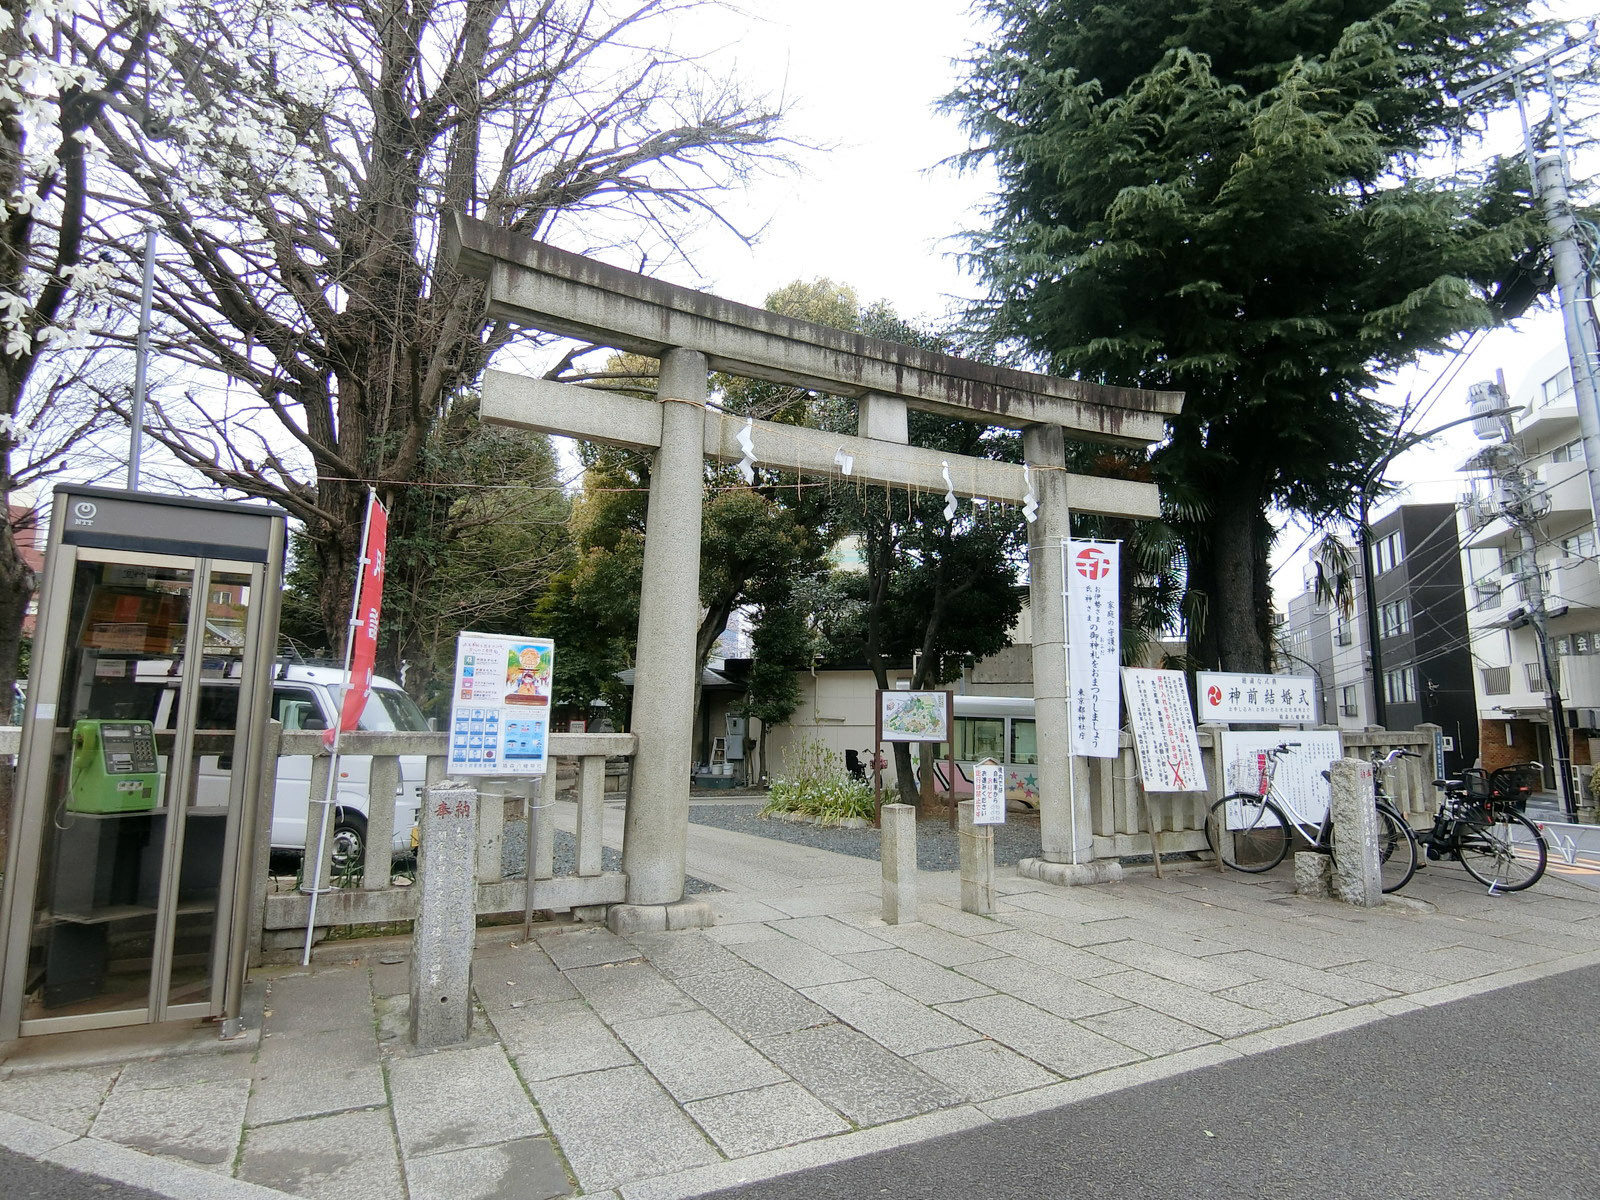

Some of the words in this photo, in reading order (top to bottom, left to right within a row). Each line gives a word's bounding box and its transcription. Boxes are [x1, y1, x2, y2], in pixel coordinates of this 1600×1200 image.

[1085, 585, 1093, 622] 氏神さま
[1093, 586, 1102, 624] お伊勢さま
[1106, 600, 1116, 655] 家庭の守護神
[1088, 624, 1100, 748] の御神札をおまつりしましょう
[1228, 687, 1310, 707] 神前結婚式
[1077, 688, 1086, 740] 東京都神社庁
[435, 800, 470, 819] 奉納
